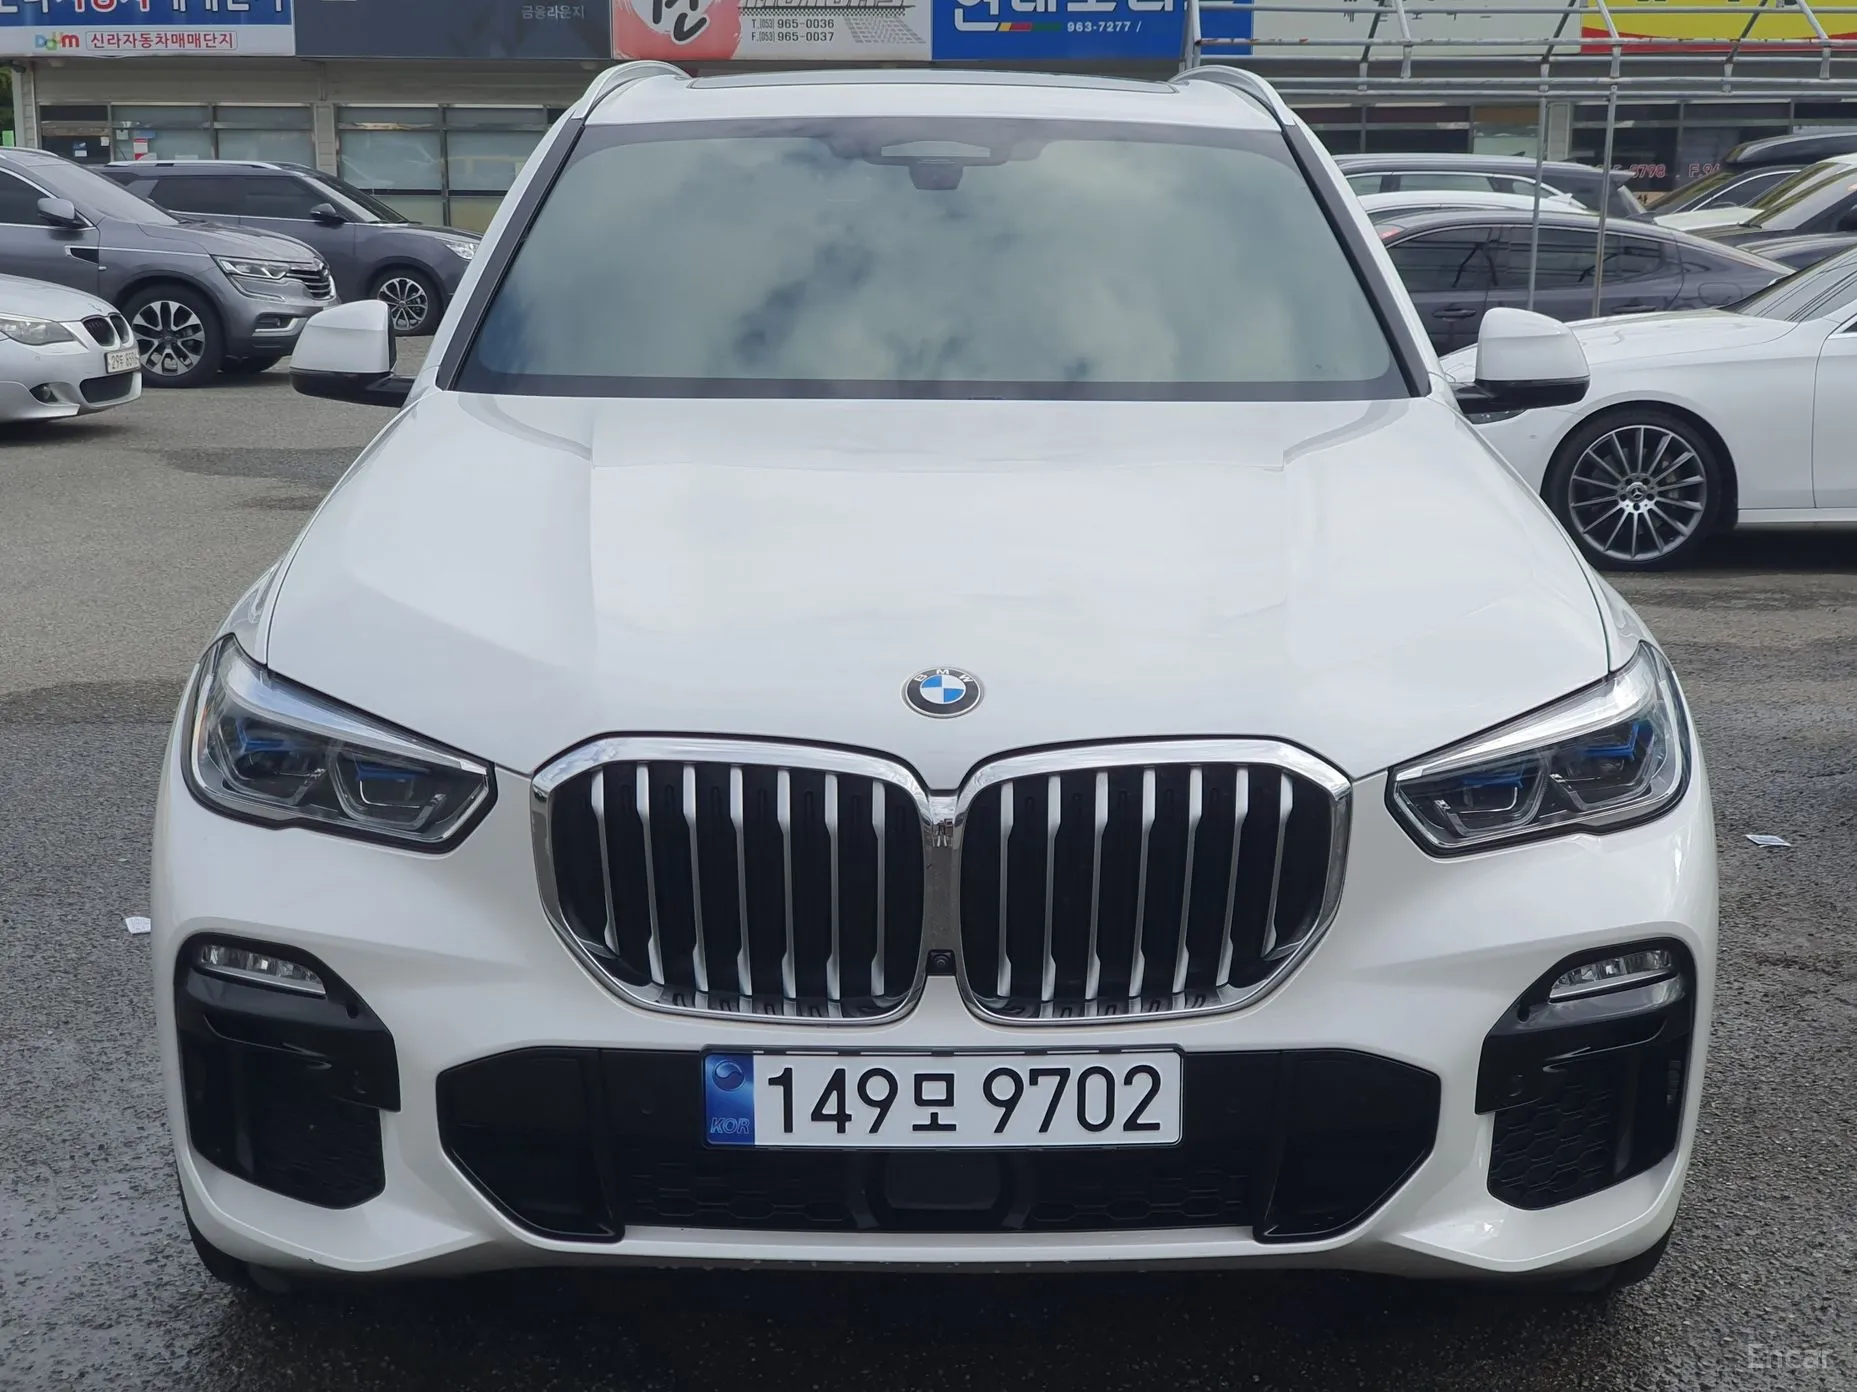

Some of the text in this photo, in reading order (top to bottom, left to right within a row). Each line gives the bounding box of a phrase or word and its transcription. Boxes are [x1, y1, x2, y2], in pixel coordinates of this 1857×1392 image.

[521, 4, 585, 20] 금융라운지
[777, 18, 835, 29] 965-0036
[91, 32, 233, 49] 신라자동차매매단지
[777, 31, 835, 42] 965-0037
[914, 669, 974, 682] BMW
[767, 1064, 1162, 1134] 149모 9702
[710, 1116, 751, 1135] KOR
